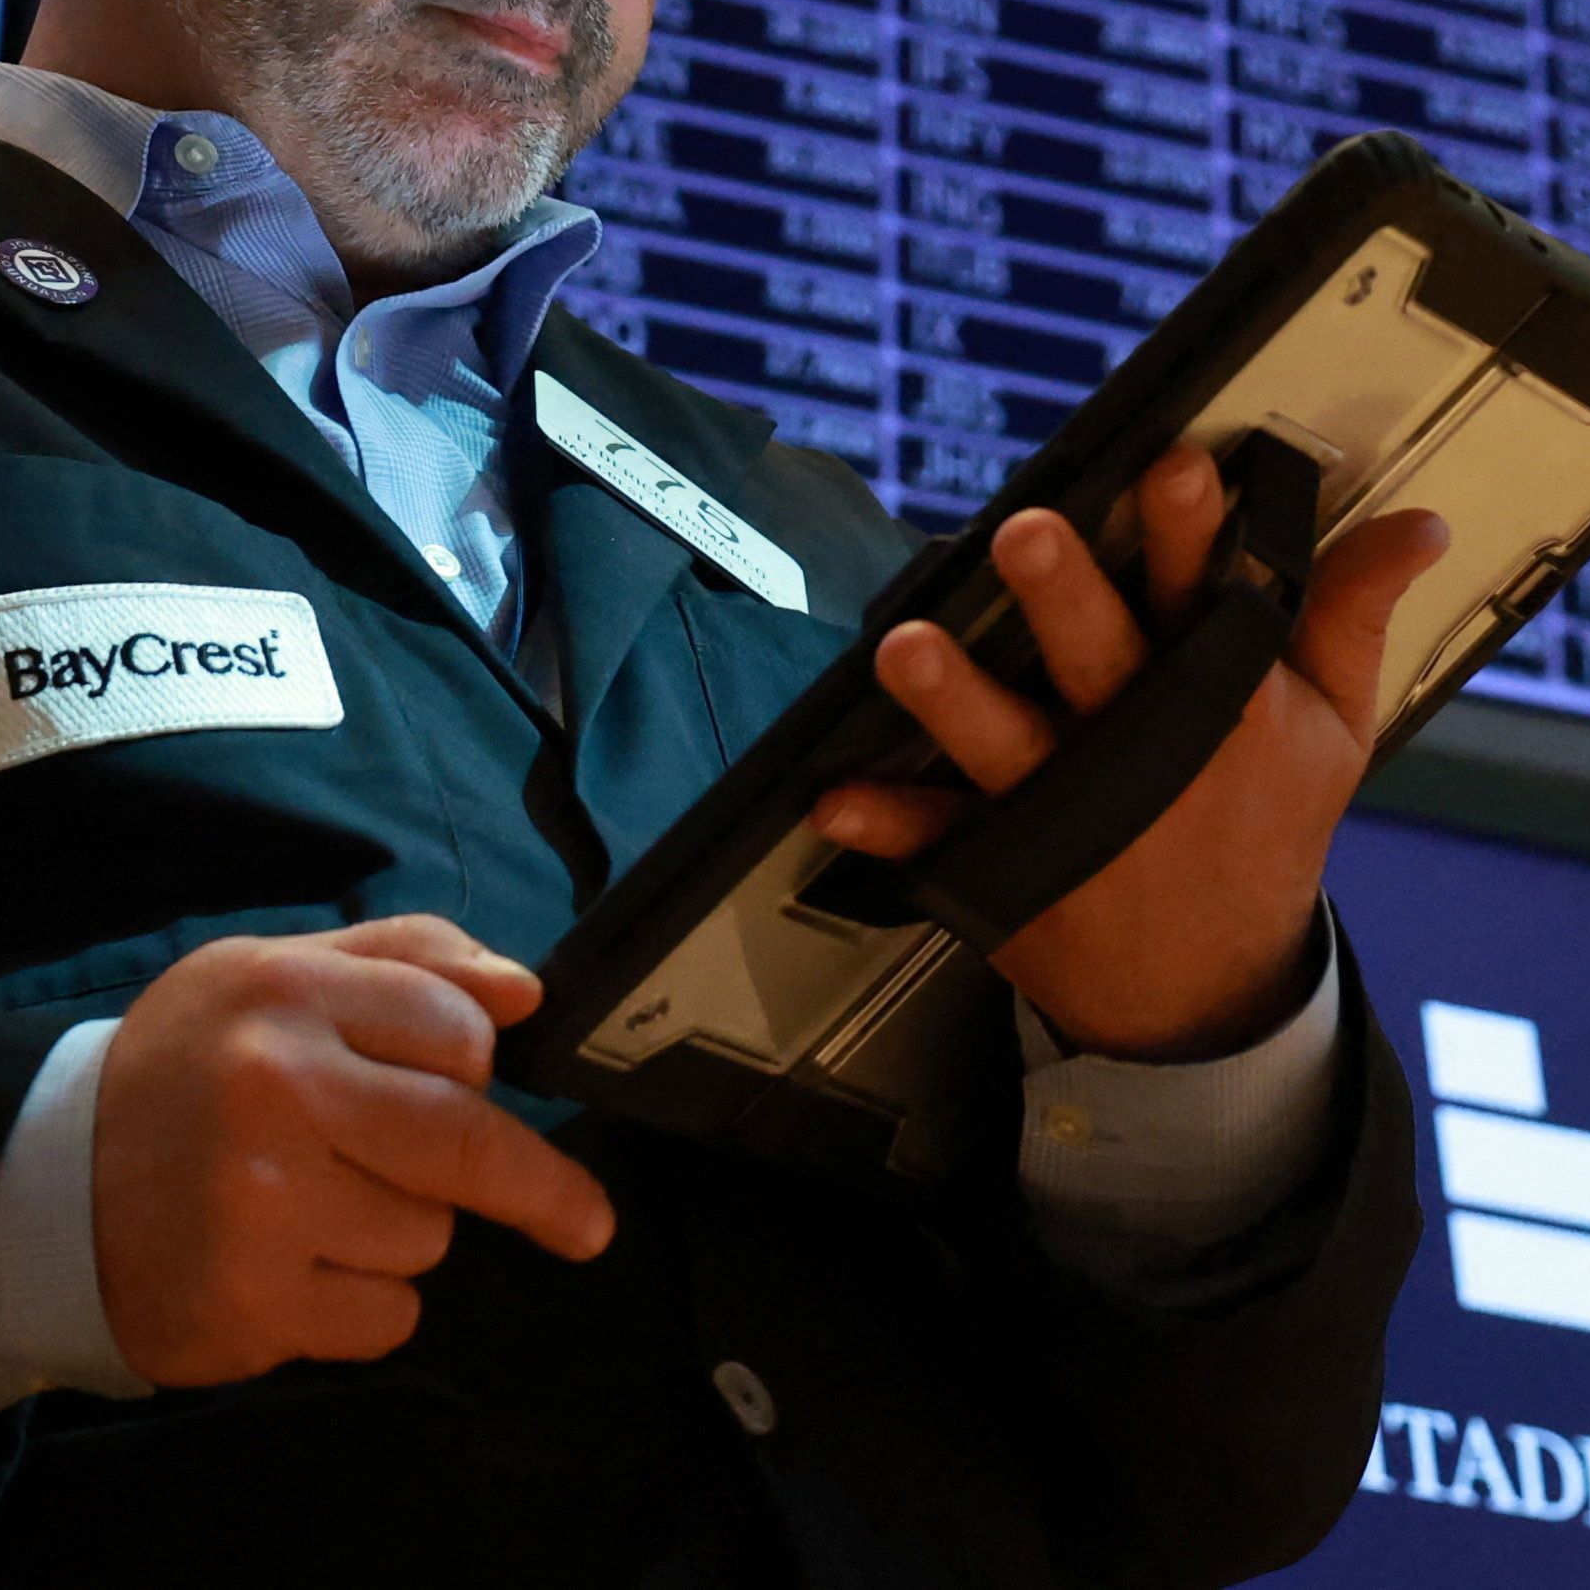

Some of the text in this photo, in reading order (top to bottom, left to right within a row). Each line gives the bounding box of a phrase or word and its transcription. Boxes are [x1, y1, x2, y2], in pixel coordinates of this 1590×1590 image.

[0, 253, 87, 299] FOUNDATION
[594, 418, 740, 544] 775
[4, 631, 286, 701] BayCrest
